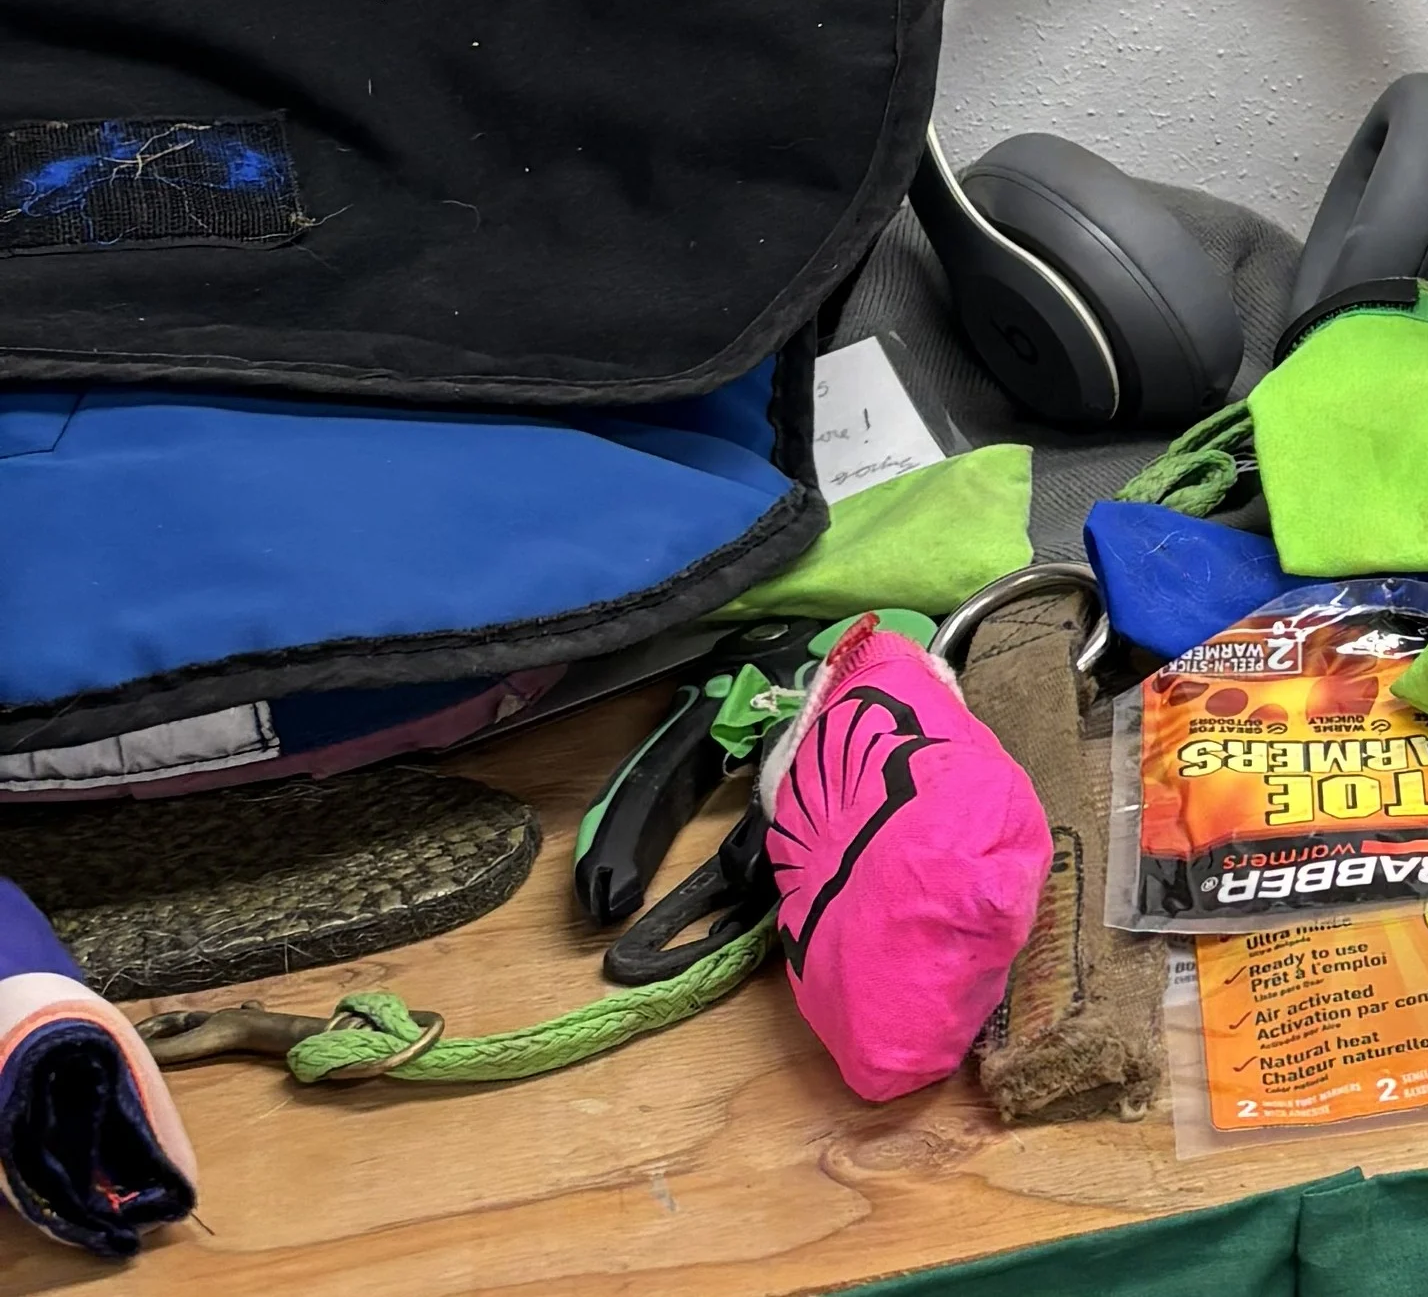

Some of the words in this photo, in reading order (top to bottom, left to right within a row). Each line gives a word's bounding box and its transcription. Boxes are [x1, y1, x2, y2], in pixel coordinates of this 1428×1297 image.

[1266, 638, 1295, 671] 2
[1307, 715, 1365, 725] QUICKLY
[1313, 723, 1366, 733] WARMS
[1223, 840, 1356, 871] warmers
[1246, 929, 1291, 951] Ultra
[1249, 951, 1305, 978] Ready
[1311, 947, 1330, 960] to
[1335, 942, 1369, 957] use
[1250, 972, 1291, 993] Prêt
[1312, 952, 1388, 976] l'emploi
[1255, 1008, 1280, 1026] Air
[1287, 984, 1375, 1016] activated
[1256, 1008, 1352, 1041] Activation
[1357, 1000, 1390, 1020] par
[1258, 1040, 1331, 1071] Natural
[1336, 1032, 1380, 1050] heat
[1261, 1056, 1337, 1087] Chaleur
[1377, 1077, 1400, 1103] 2
[1236, 1099, 1259, 1118] 2
